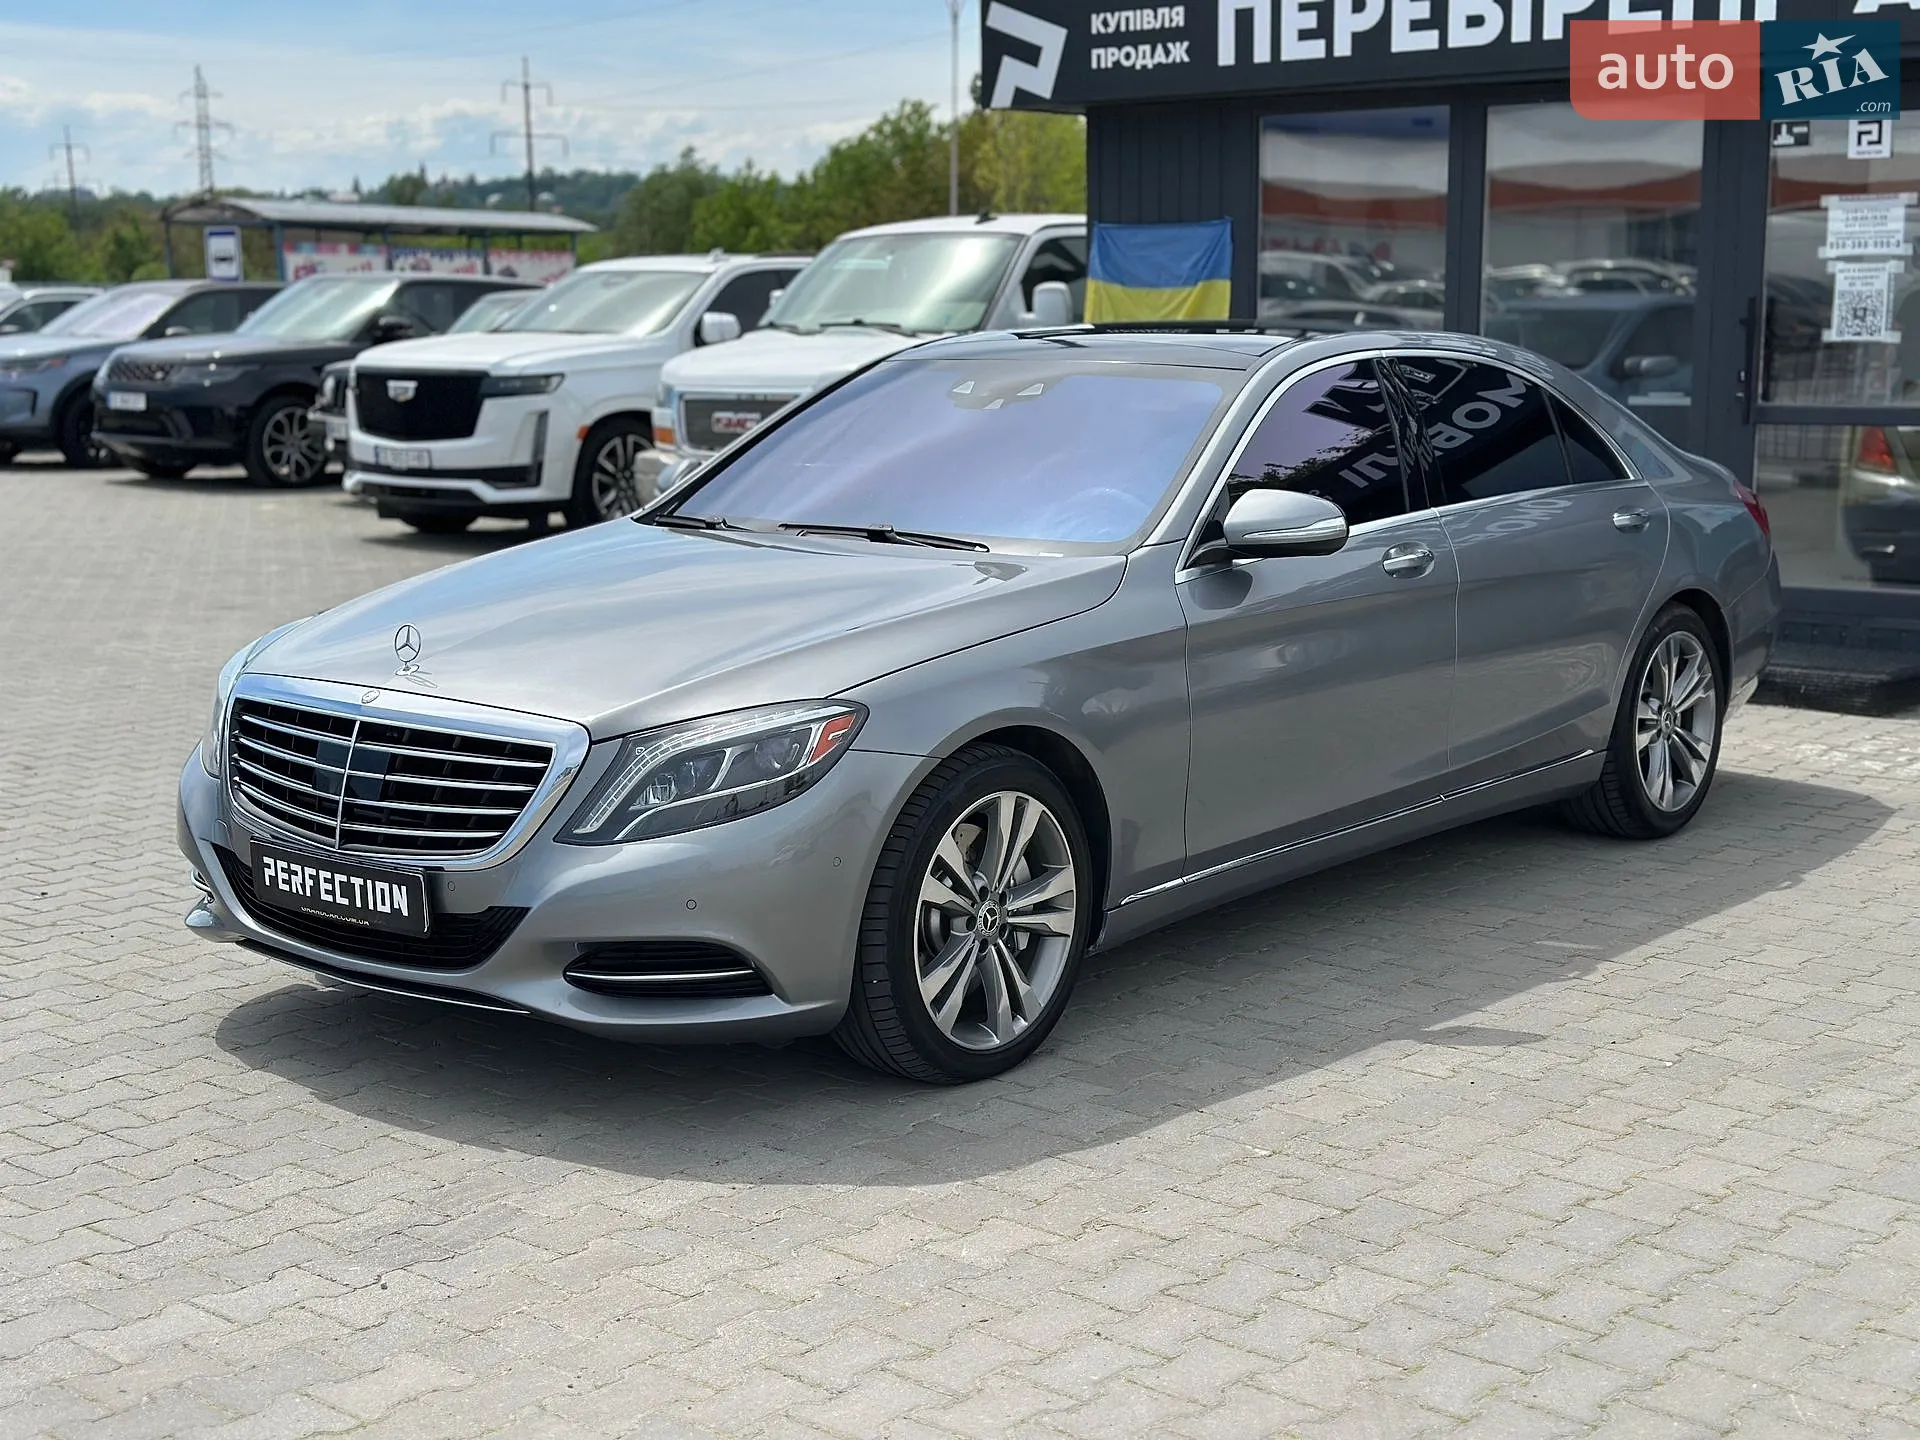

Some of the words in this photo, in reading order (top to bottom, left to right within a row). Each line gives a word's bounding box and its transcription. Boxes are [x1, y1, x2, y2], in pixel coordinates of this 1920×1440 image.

[1090, 5, 1185, 35] КУПІВЛЯ
[1217, 0, 1777, 66] ПЕРЕВІ
[1090, 40, 1190, 70] ПРОДАЖ
[262, 855, 409, 917] PERFECTION
